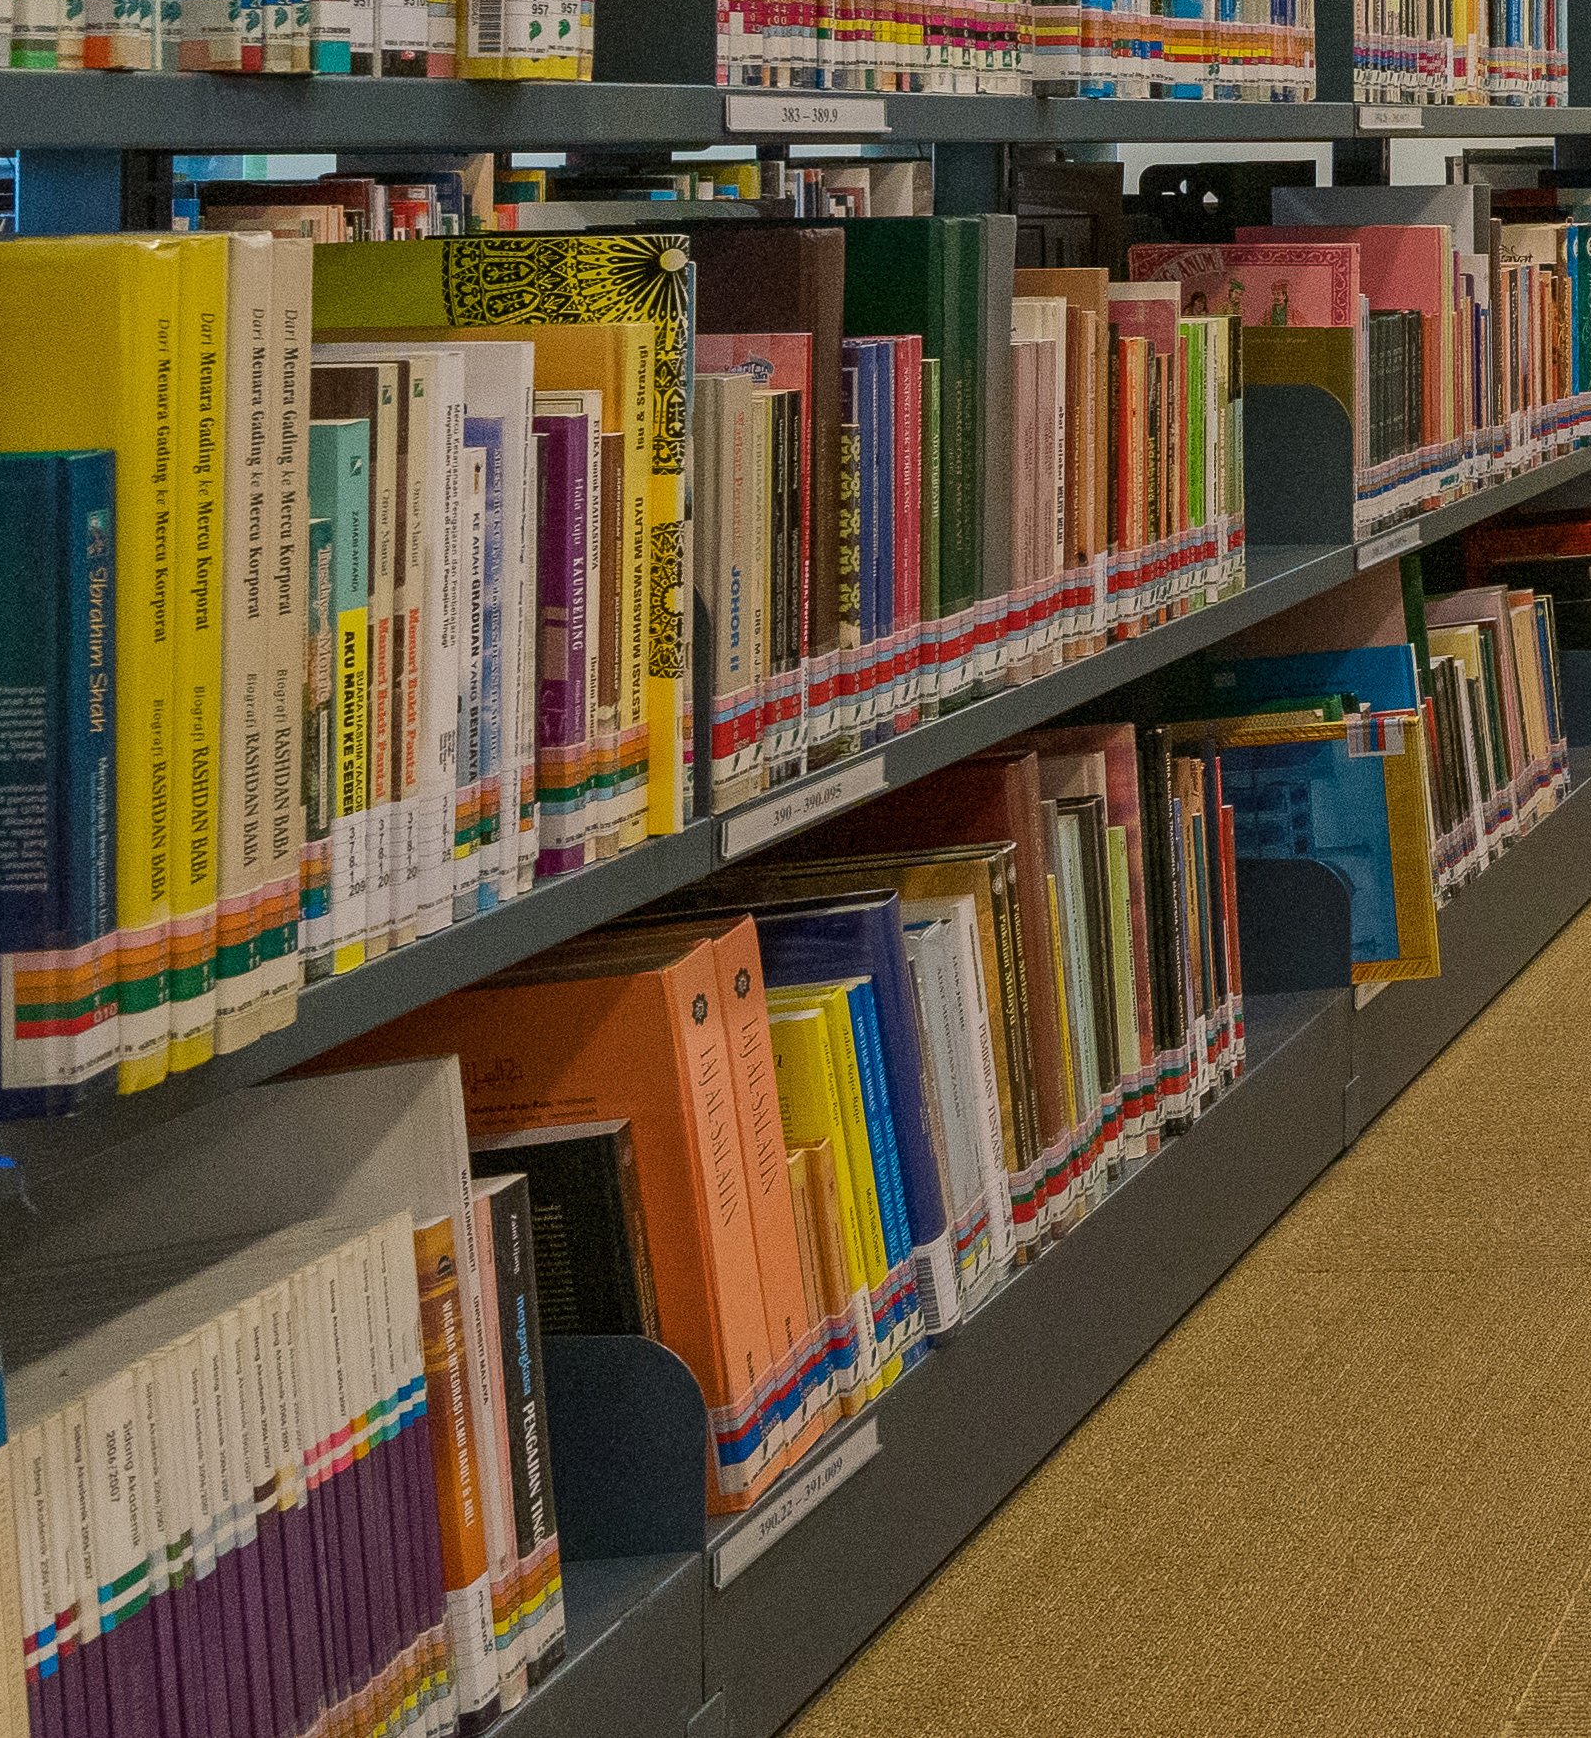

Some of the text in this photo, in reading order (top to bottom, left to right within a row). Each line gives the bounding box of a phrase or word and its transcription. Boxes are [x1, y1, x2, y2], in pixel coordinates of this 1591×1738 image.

[781, 107, 801, 123] 383
[152, 319, 171, 643] Dari Menara Gading ke Mercu Korporat
[245, 309, 265, 619] Dari Menara Gading ke Mercu Korporat
[571, 556, 583, 651] KAUNSELING
[730, 565, 742, 647] JOHOR
[151, 760, 166, 848] RASHDAN
[244, 728, 259, 868] RASHDAN BABA
[773, 809, 793, 826] 390
[150, 852, 165, 902] BABA
